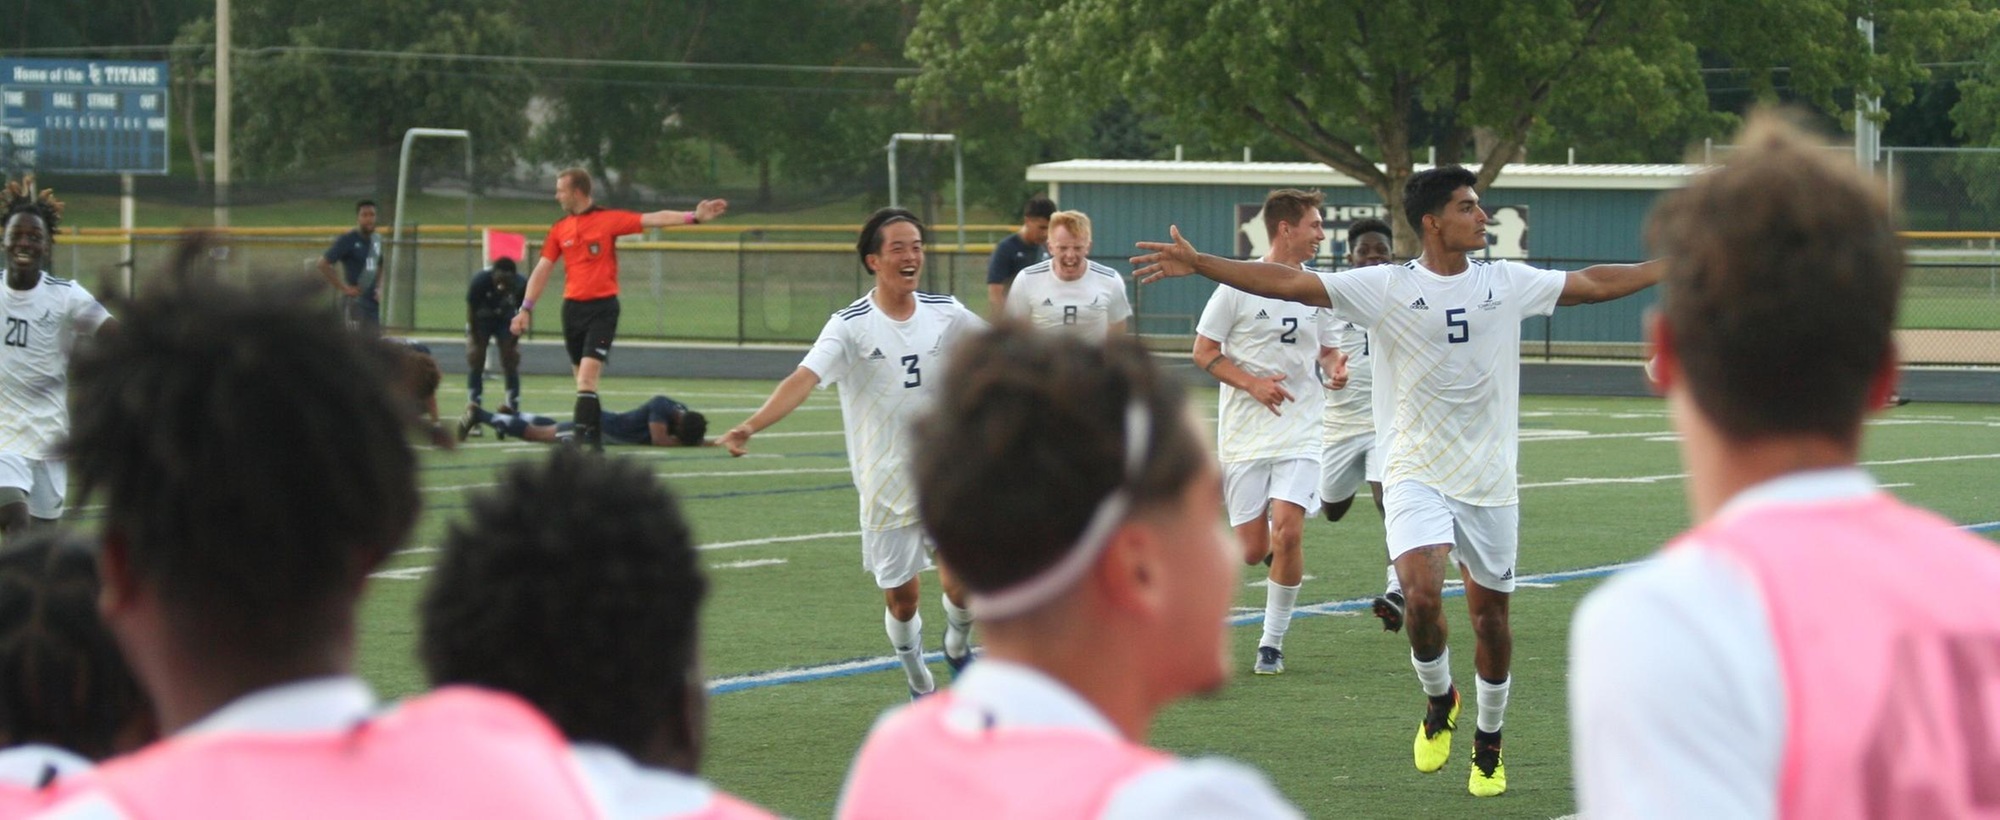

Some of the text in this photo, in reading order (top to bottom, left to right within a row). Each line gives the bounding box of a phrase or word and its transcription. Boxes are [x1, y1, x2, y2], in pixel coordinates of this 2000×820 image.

[13, 66, 47, 82] Home
[50, 67, 62, 83] of
[64, 67, 84, 84] the
[104, 66, 159, 85] TITANS
[87, 93, 118, 110] STRIKE
[1063, 304, 1078, 326] 8
[1445, 307, 1470, 344] 5
[5, 316, 28, 348] 20
[1280, 317, 1298, 344] 2
[900, 354, 921, 389] 3
